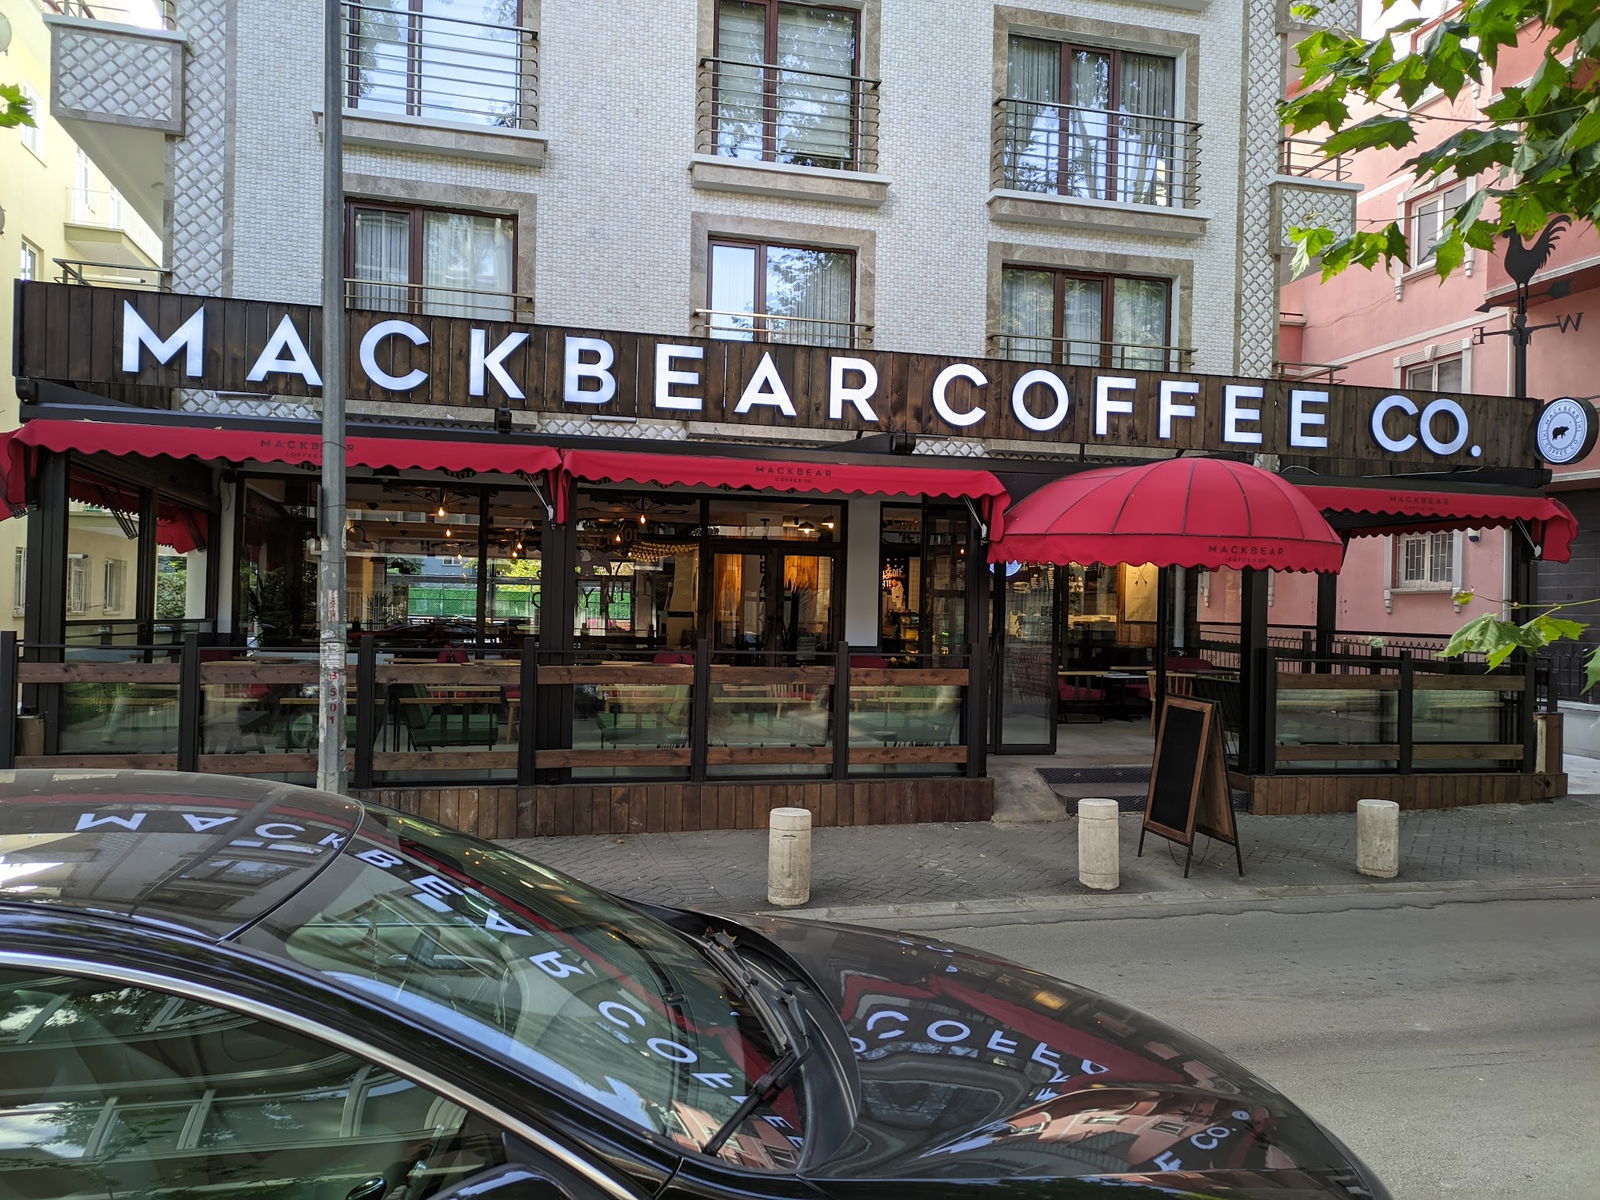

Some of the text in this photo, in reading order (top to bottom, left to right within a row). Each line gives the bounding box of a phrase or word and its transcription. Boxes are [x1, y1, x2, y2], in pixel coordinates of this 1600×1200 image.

[122, 300, 1482, 458] MACKBEAR COFFEE CO.
[1545, 406, 1580, 425] MACKBEAR
[260, 440, 354, 452] MACKBR
[1545, 443, 1567, 454] COFFEE
[755, 466, 832, 477] MACKBEAR
[1389, 496, 1449, 505] MACKBEAR
[1208, 545, 1285, 556] MACKBEAR
